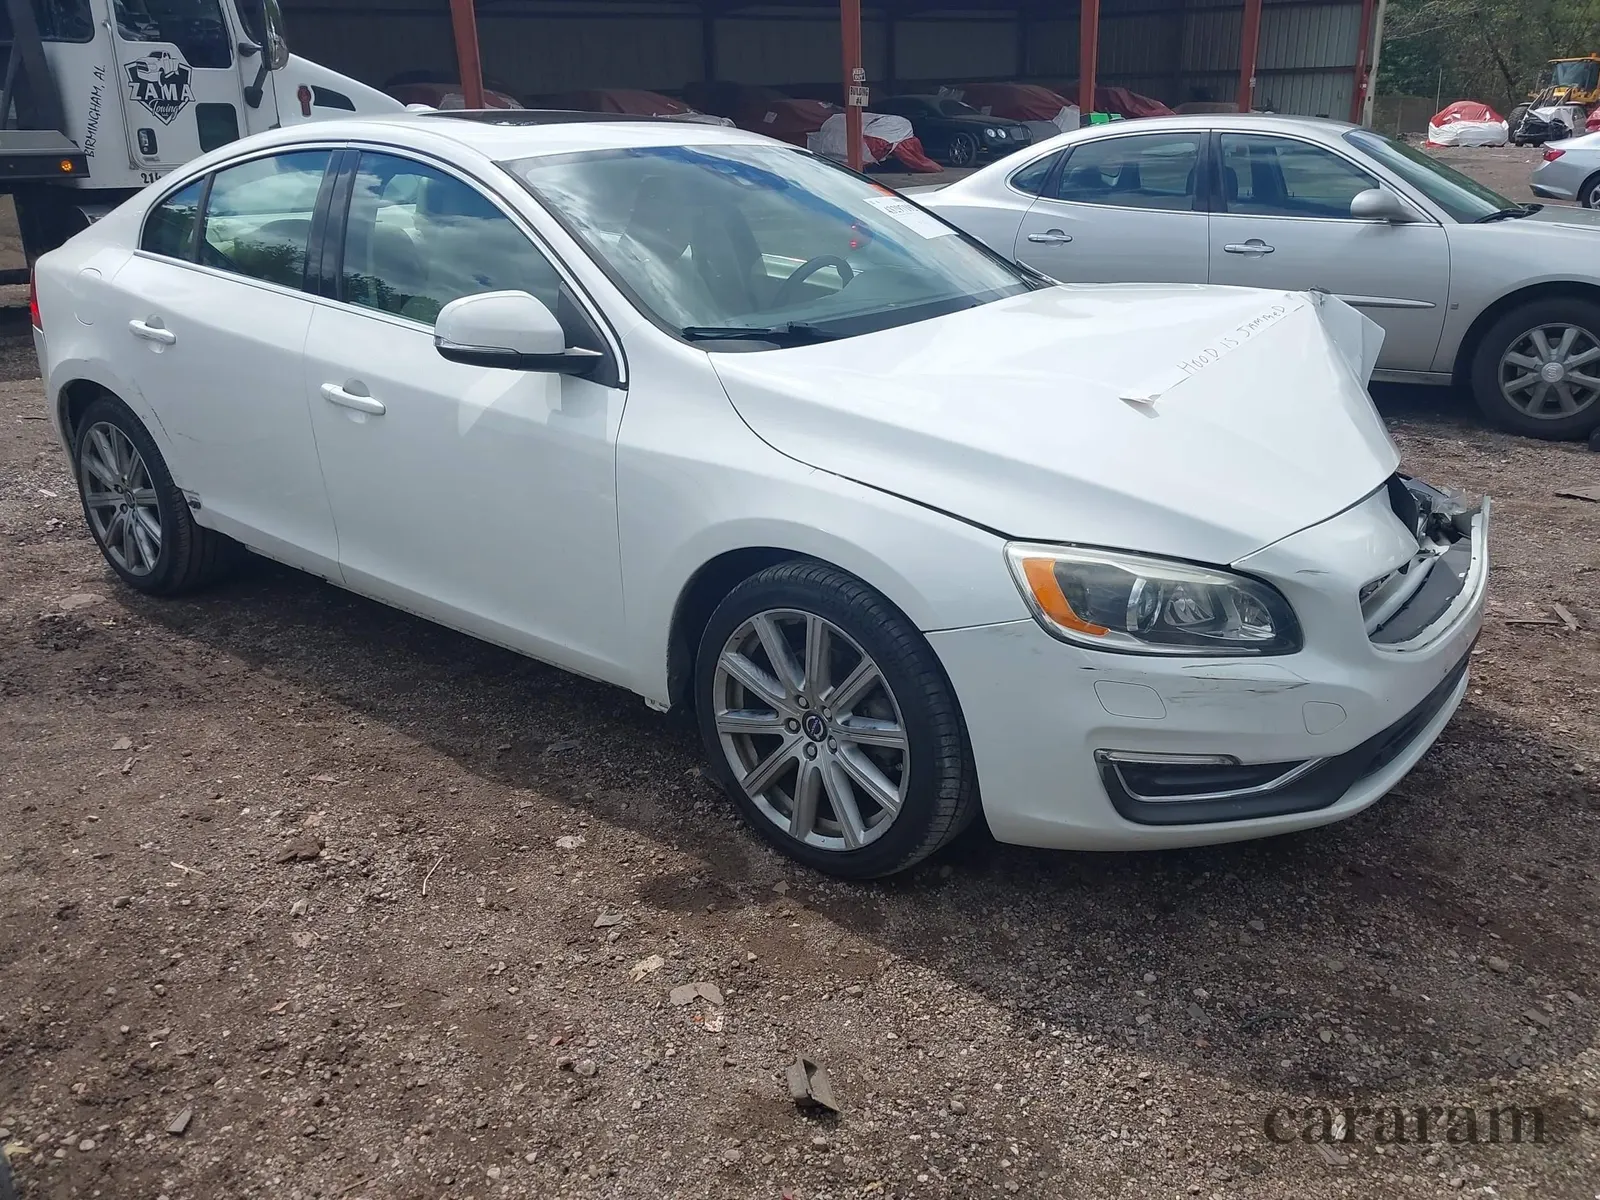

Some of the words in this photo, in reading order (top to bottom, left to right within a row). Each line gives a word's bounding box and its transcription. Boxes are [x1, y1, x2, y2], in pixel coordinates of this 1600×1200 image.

[128, 82, 196, 101] ZAMA
[148, 99, 179, 120] Towing
[1177, 348, 1219, 375] HOOD
[1220, 337, 1239, 349] IS
